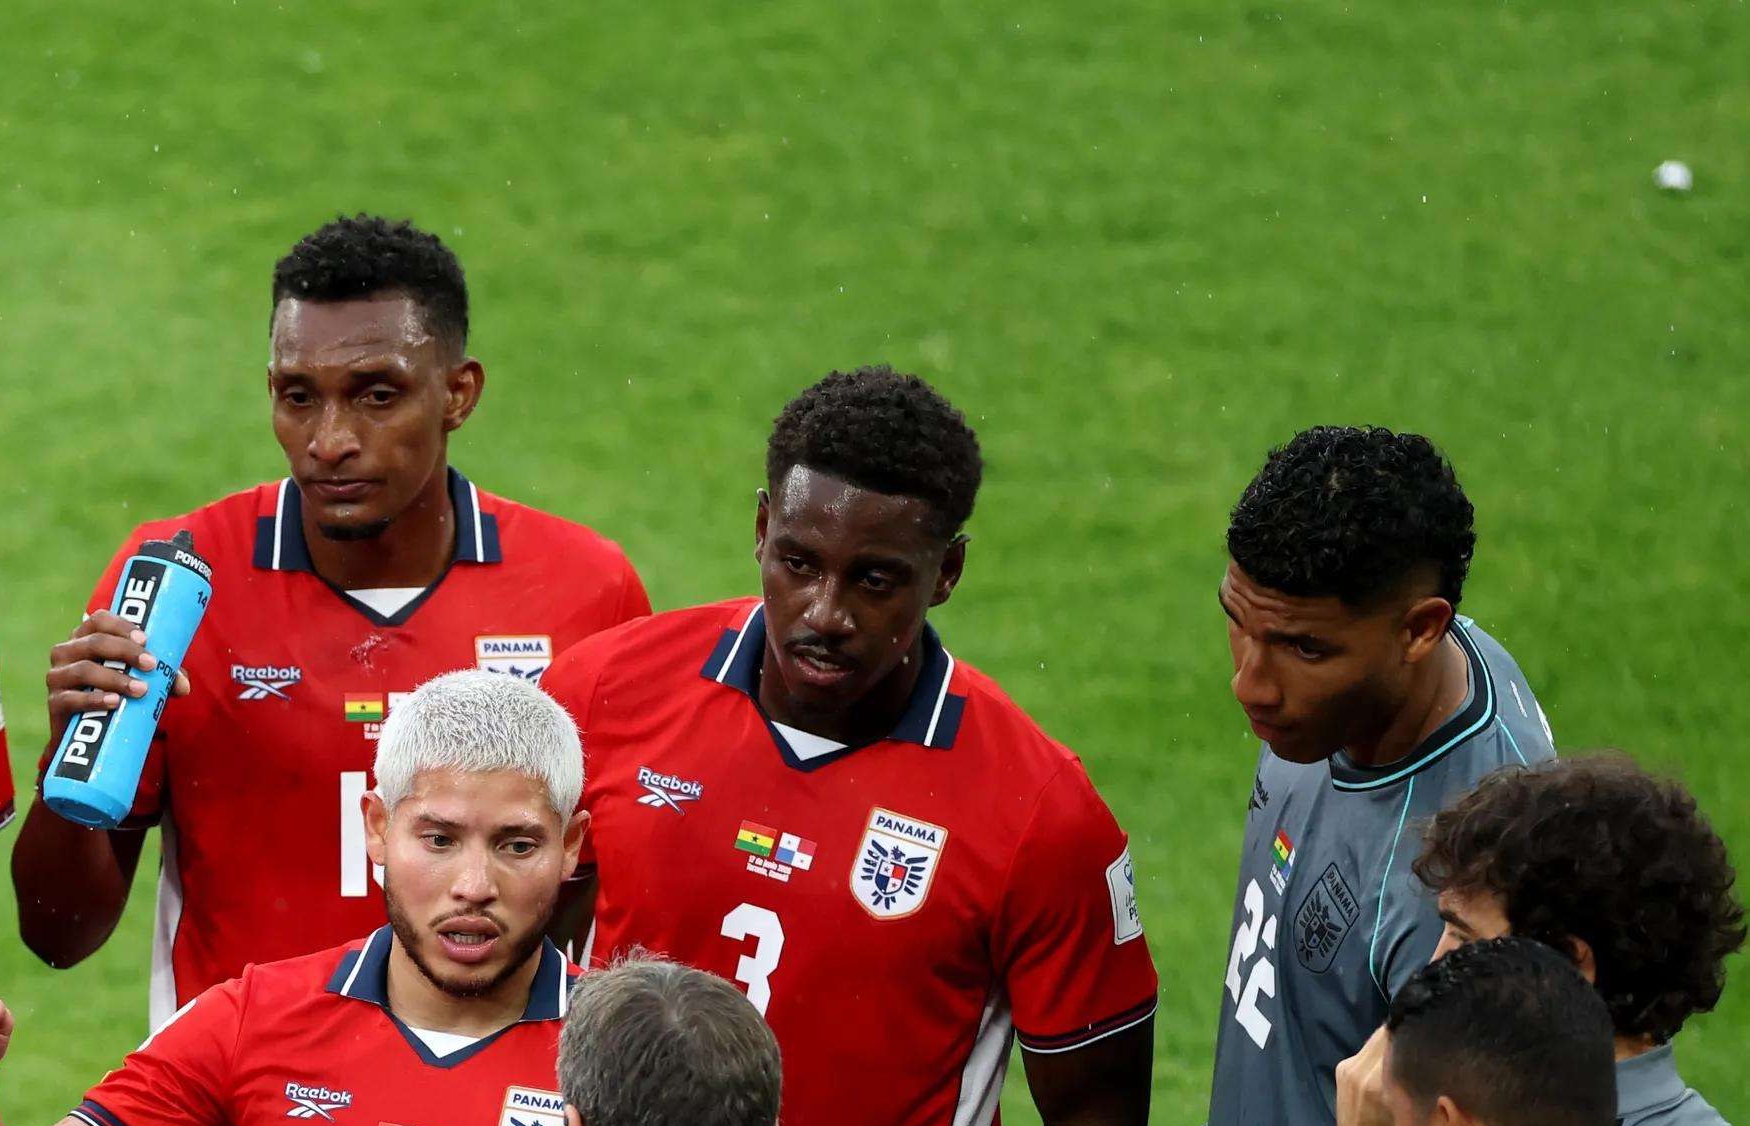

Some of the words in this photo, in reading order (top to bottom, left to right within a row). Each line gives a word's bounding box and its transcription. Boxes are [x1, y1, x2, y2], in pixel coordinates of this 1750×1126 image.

[483, 640, 544, 653] PANAMÁ
[62, 577, 154, 767] PODE
[231, 664, 301, 680] Reebok
[637, 766, 703, 797] Reebok
[876, 815, 936, 844] PANAMÁ
[1326, 870, 1356, 919] PANAMÁ
[720, 902, 786, 1019] 3
[285, 1082, 352, 1104] Reebok
[512, 1092, 565, 1111] PANAM
